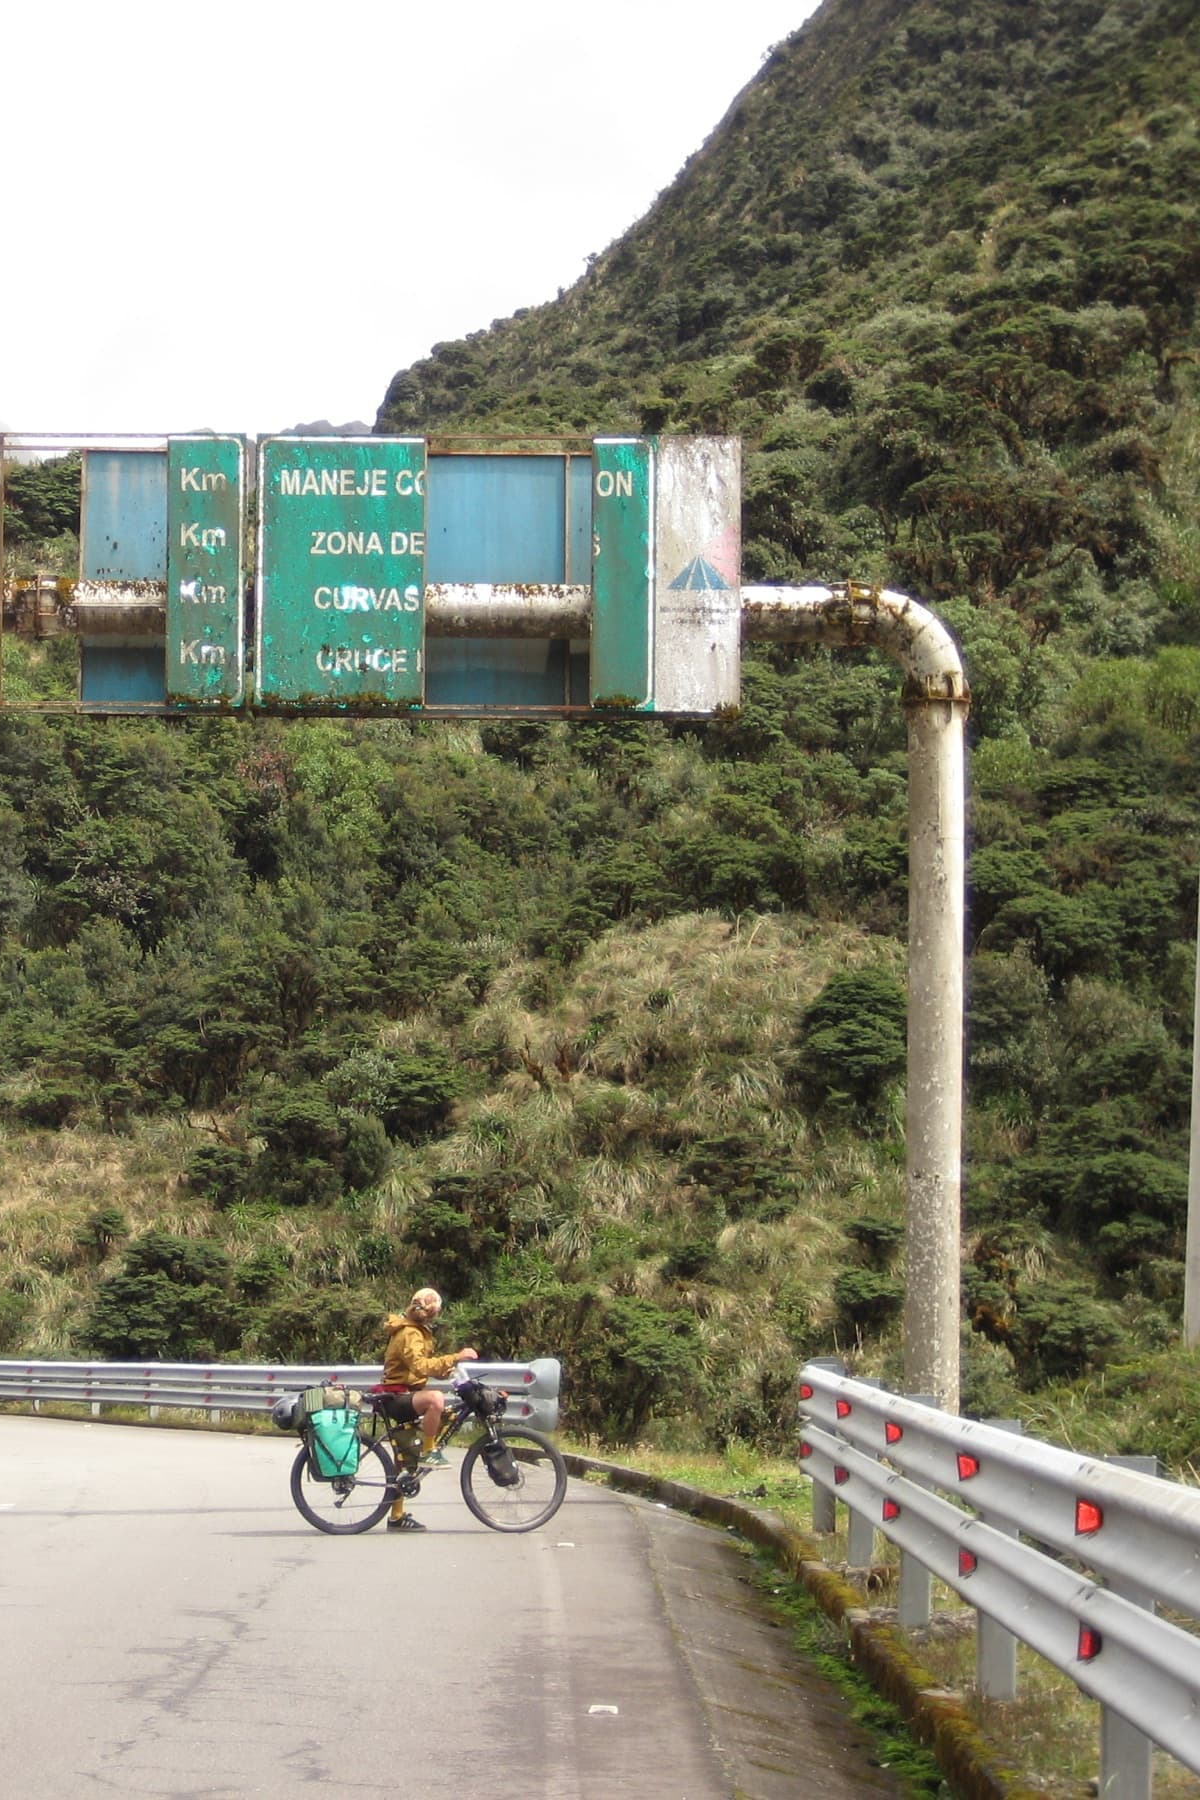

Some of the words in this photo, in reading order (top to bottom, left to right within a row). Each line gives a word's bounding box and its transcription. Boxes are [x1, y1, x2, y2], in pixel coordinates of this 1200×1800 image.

[181, 468, 226, 491] Km
[280, 469, 387, 496] MANEJE
[595, 470, 633, 497] ON
[180, 523, 226, 547] Km
[310, 532, 383, 555] ZONA
[391, 532, 425, 555] DE
[180, 580, 226, 604] Km
[314, 585, 419, 611] CURVAS
[180, 639, 225, 664] Km
[316, 648, 407, 672] CRUCE
